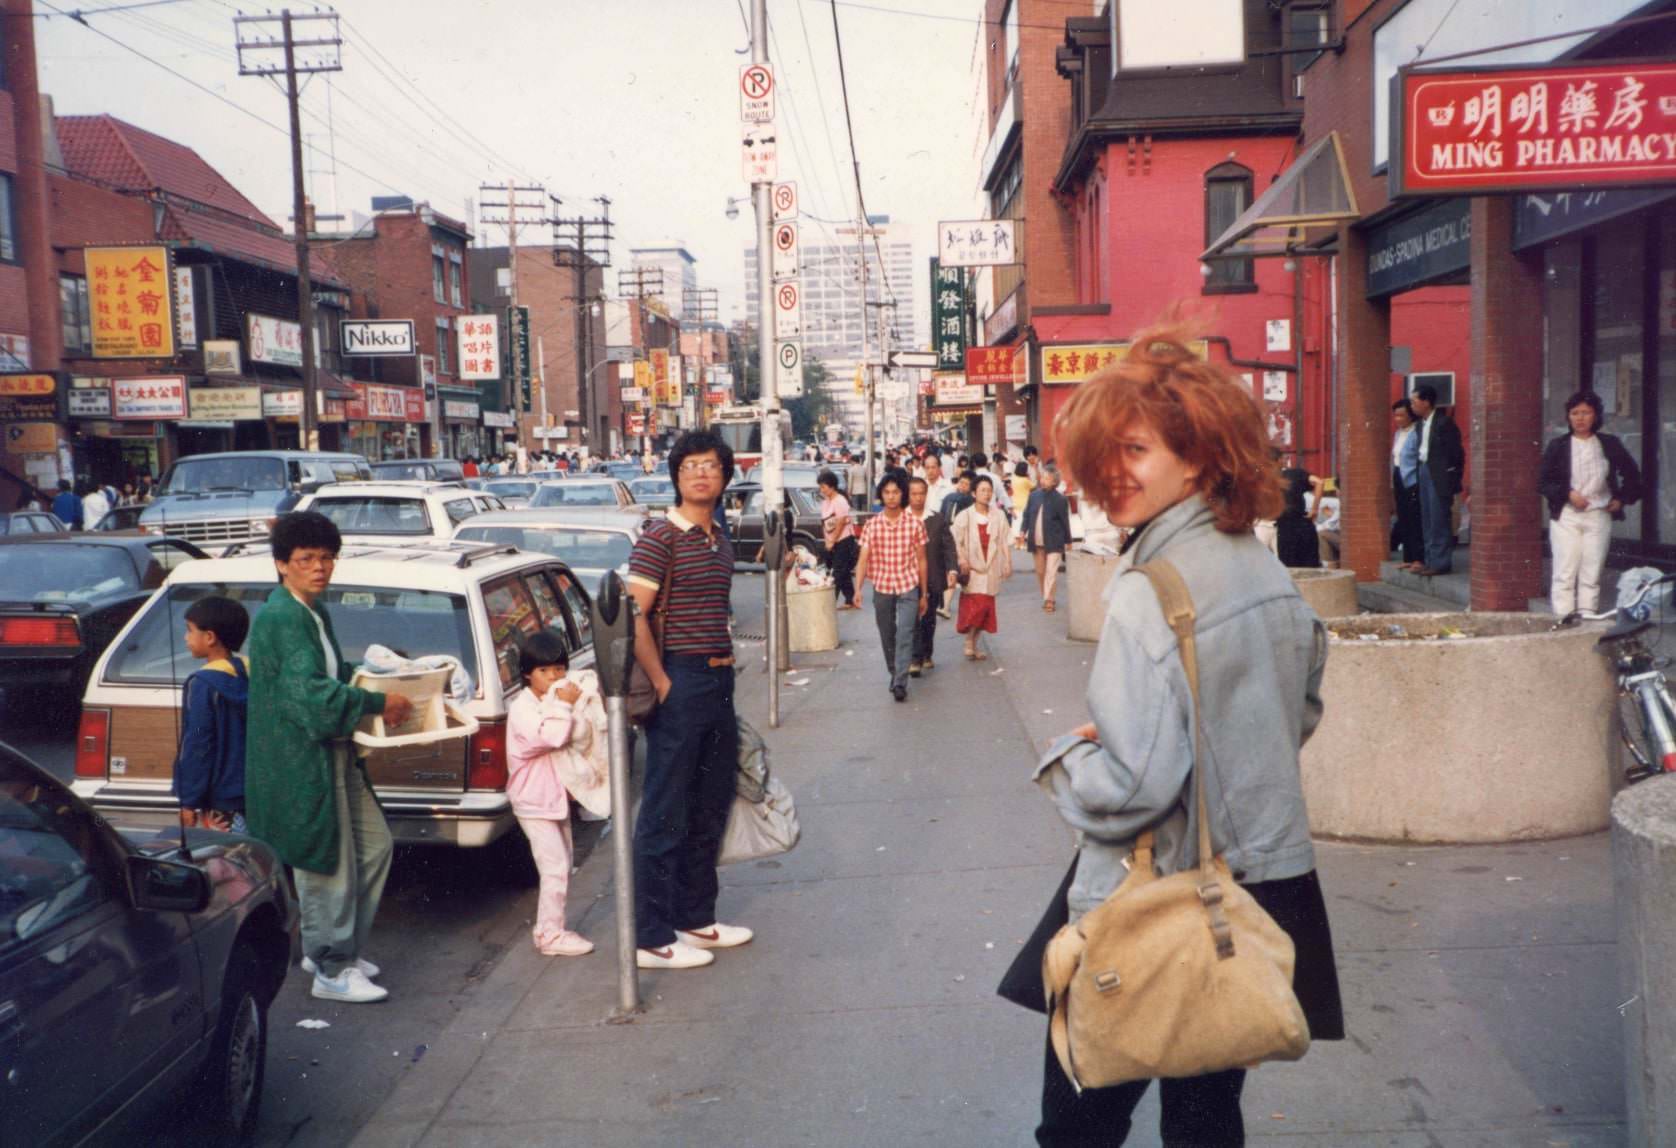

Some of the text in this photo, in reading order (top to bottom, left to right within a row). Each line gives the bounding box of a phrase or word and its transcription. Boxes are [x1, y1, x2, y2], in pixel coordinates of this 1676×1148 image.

[745, 110, 770, 119] ROUTE
[1464, 76, 1648, 137] 明明藥房
[1431, 133, 1676, 170] MING PHARMACY
[1425, 221, 1459, 252] MEDICAL
[349, 326, 406, 346] Nikko
